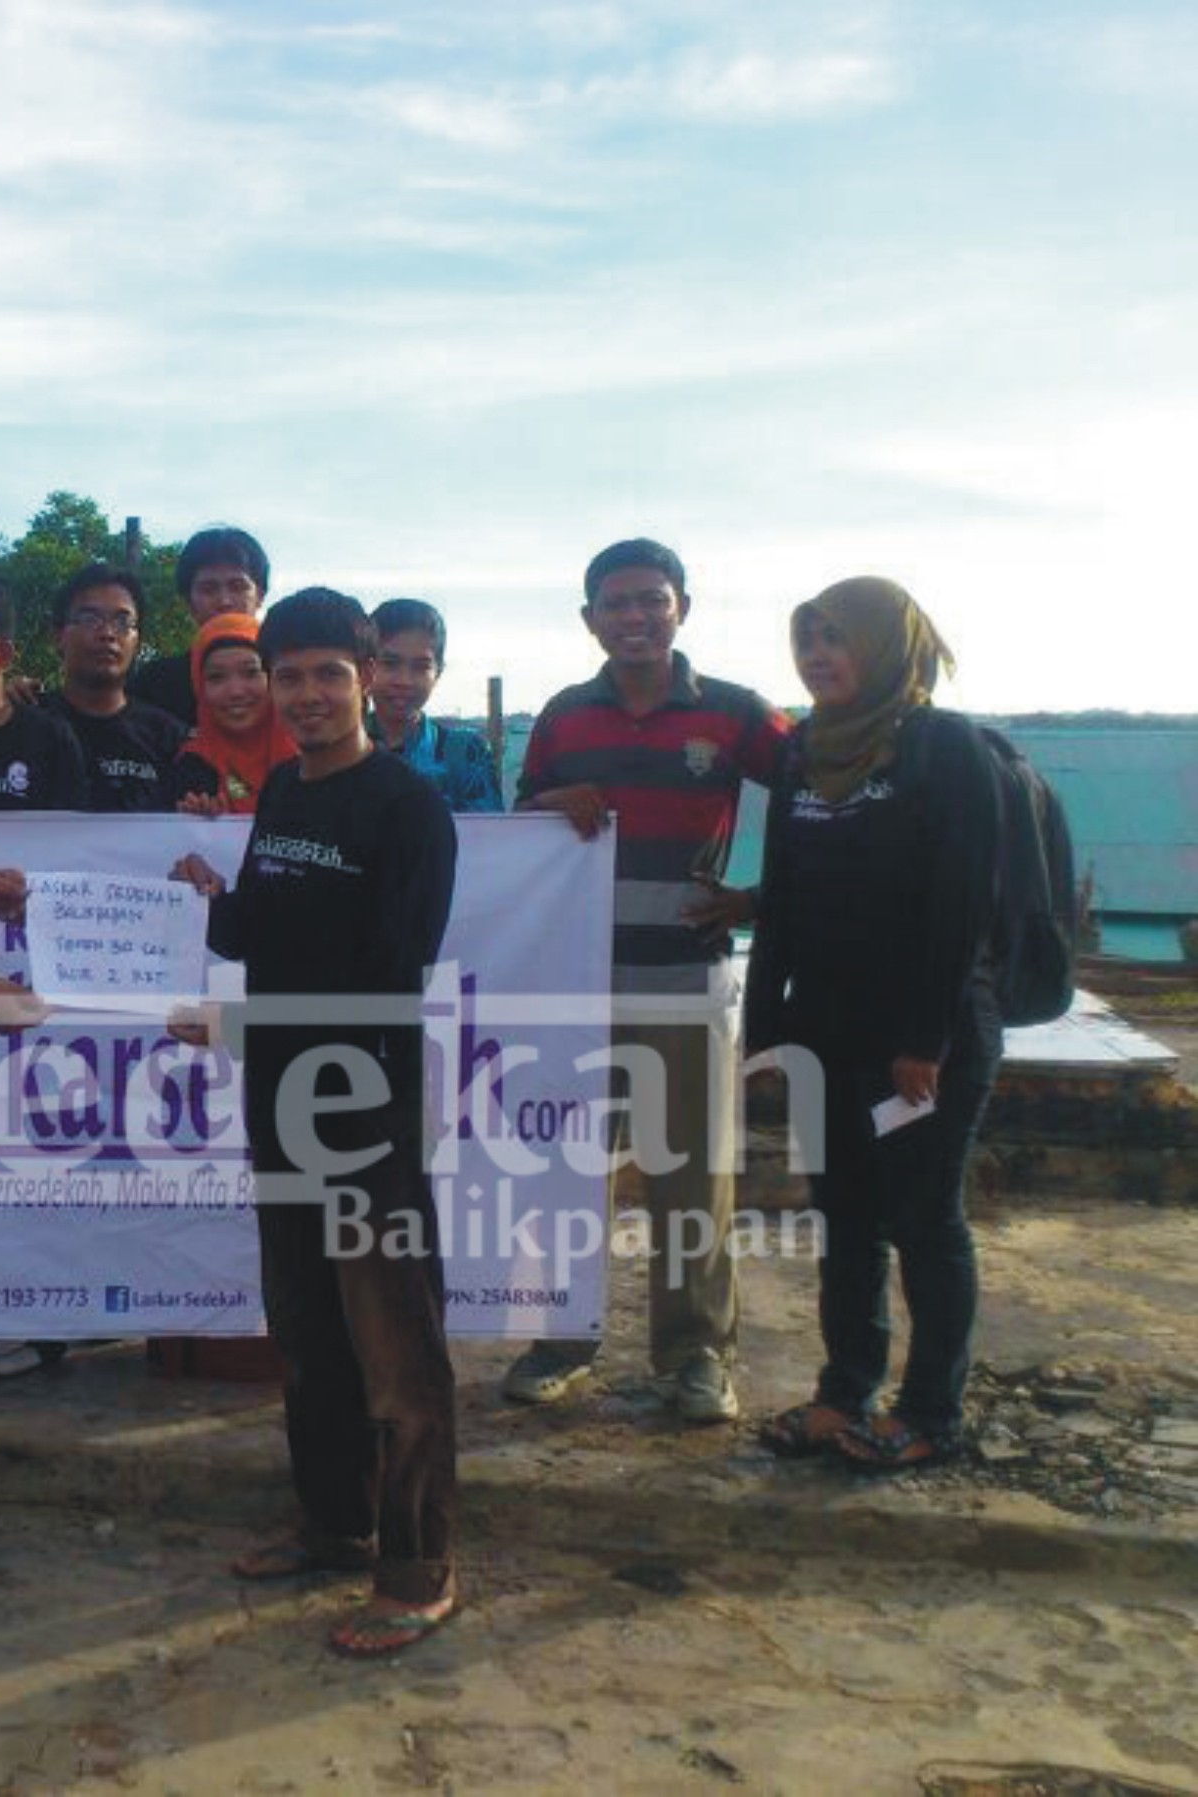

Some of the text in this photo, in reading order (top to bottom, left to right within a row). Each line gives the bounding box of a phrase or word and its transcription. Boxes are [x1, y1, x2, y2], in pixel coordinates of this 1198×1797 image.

[117, 1169, 177, 1210] Maka
[185, 1170, 228, 1210] Kita
[42, 1288, 89, 1307] 7773
[133, 1290, 180, 1308] Laskar
[184, 1290, 248, 1308] Sedekah
